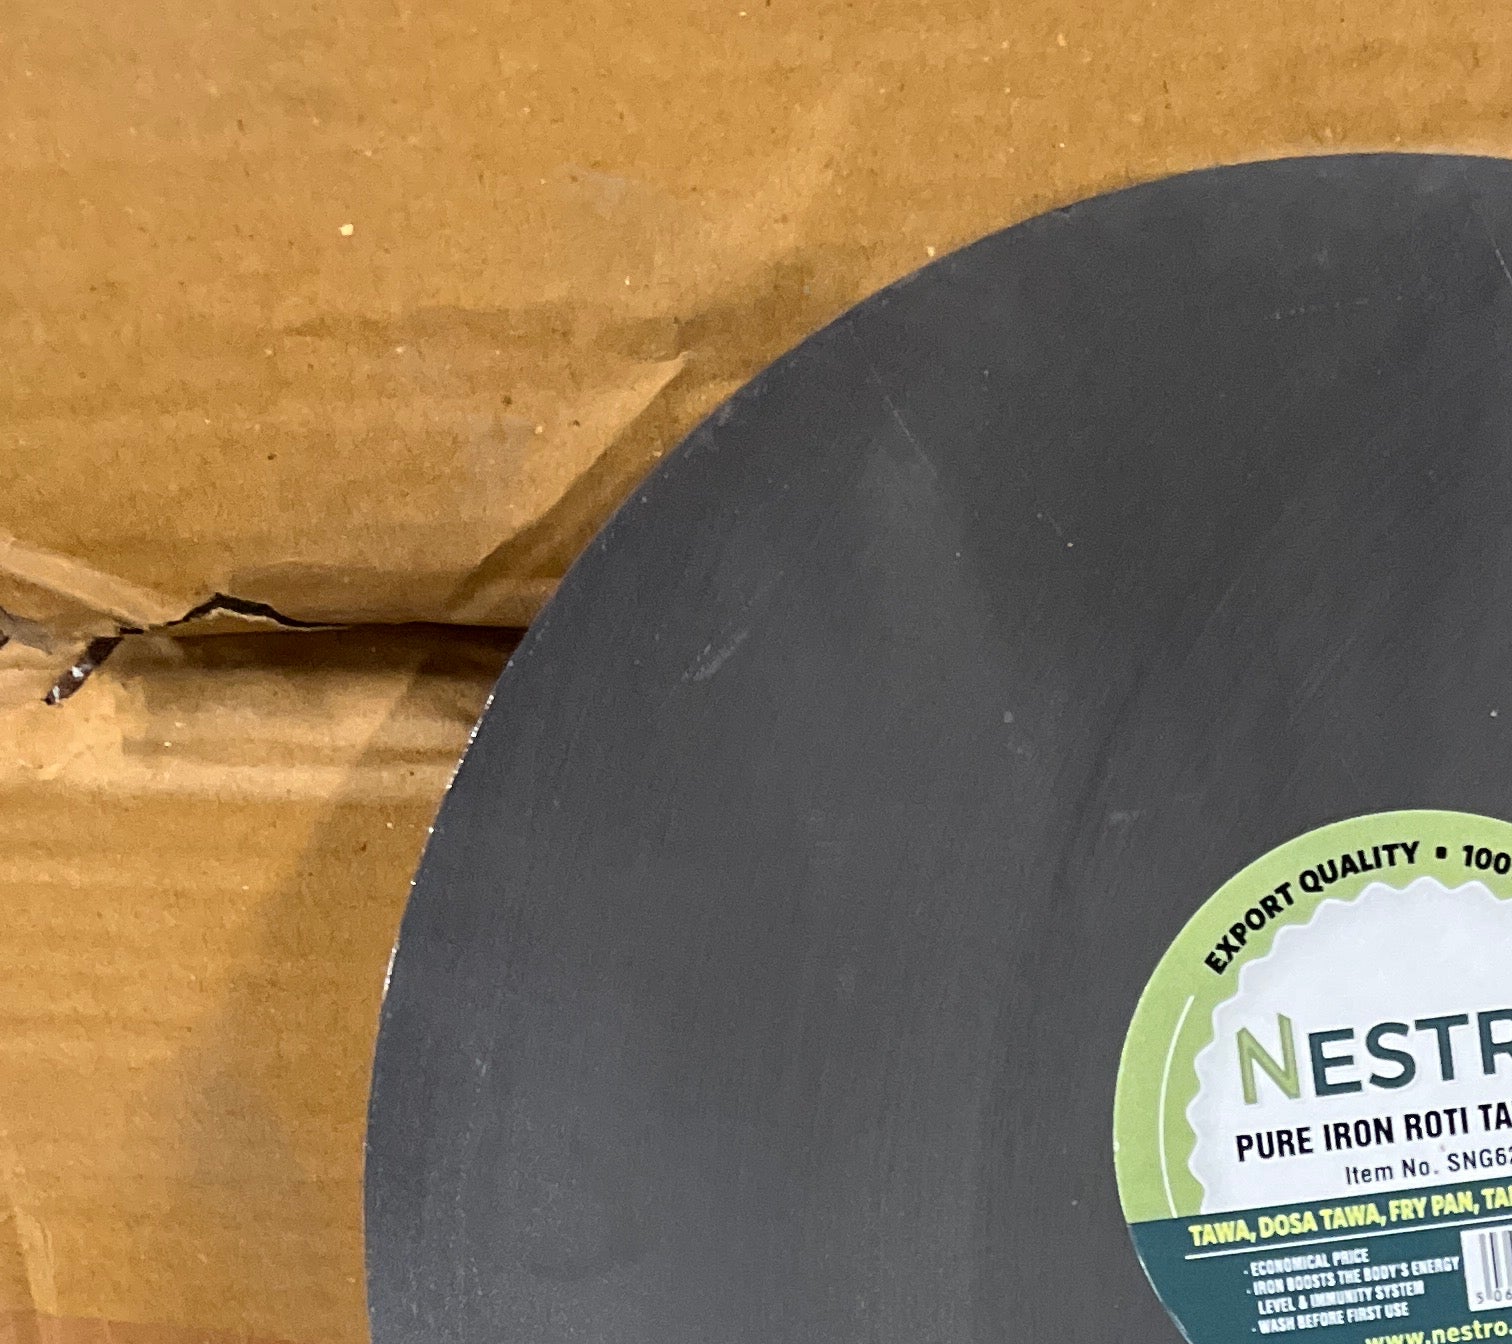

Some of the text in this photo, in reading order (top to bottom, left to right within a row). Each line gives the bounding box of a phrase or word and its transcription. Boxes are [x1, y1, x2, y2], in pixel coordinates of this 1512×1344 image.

[1204, 881, 1294, 975] EXPORT
[1298, 841, 1420, 893] QUALITY
[1236, 1126, 1314, 1162] PURE
[1323, 1115, 1394, 1151] IRON
[1404, 1105, 1469, 1142] ROTI
[1345, 1165, 1394, 1185] Item
[1402, 1157, 1439, 1179] No.
[1188, 1219, 1256, 1247] TAWA,
[1258, 1211, 1318, 1239] DOSA
[1319, 1203, 1387, 1230] TAWA,
[1389, 1196, 1427, 1222] FRY
[1431, 1190, 1479, 1216] PAN,
[1250, 1248, 1370, 1277] ECONOMICAL PRICE
[1253, 1278, 1285, 1296] IRON
[1286, 1272, 1336, 1292] BOOSTS
[1337, 1269, 1362, 1285] THE
[1411, 1256, 1460, 1276] ENERGY
[1258, 1280, 1425, 1315] LEVEL & IMMUNITY SYSTEM
[1258, 1302, 1410, 1335] WASH BEFORE FIRST USE
